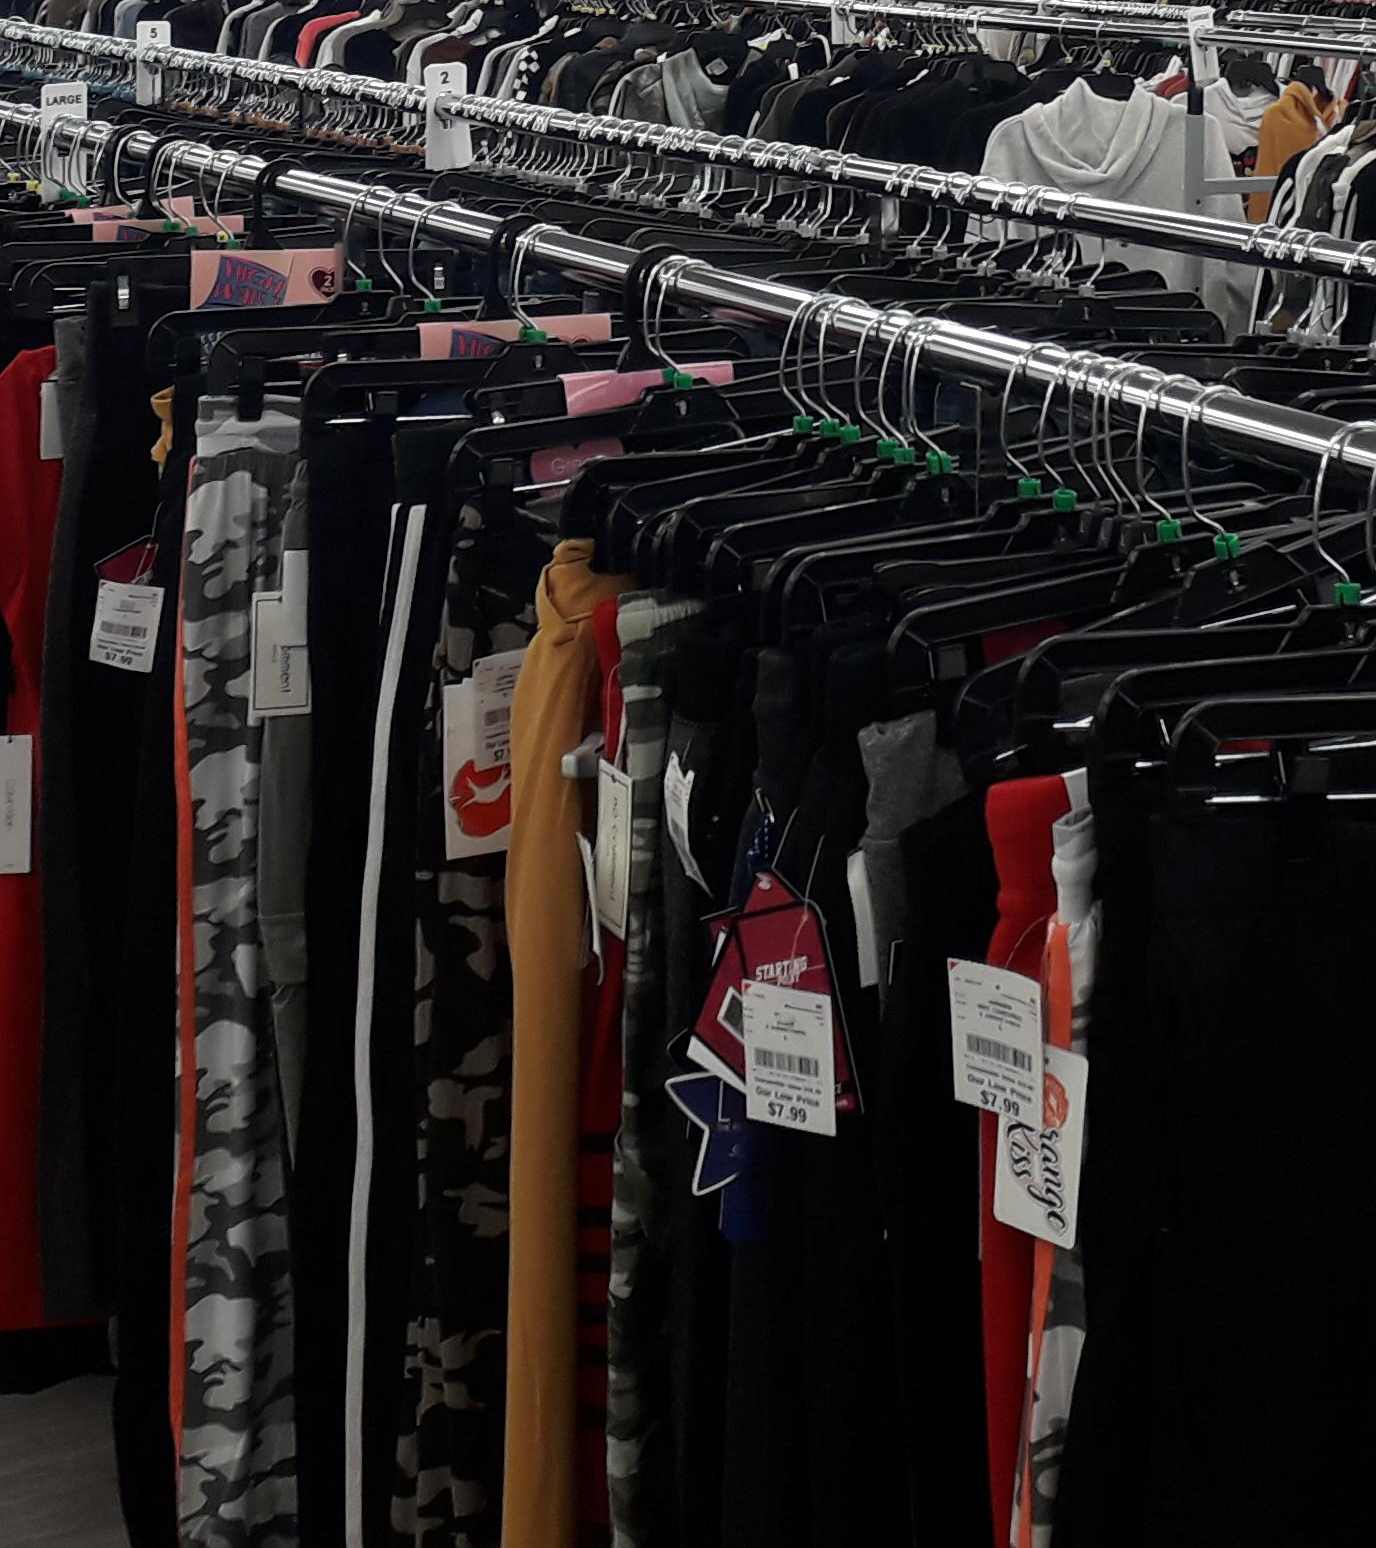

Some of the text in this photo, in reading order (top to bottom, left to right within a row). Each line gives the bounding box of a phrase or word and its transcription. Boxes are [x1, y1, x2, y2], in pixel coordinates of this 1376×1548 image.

[150, 27, 158, 39] 5
[439, 71, 451, 85] 2
[45, 93, 83, 106] LARGE
[755, 955, 809, 982] STARTING
[767, 1101, 808, 1124] $7.99
[980, 1089, 1022, 1118] $7.99
